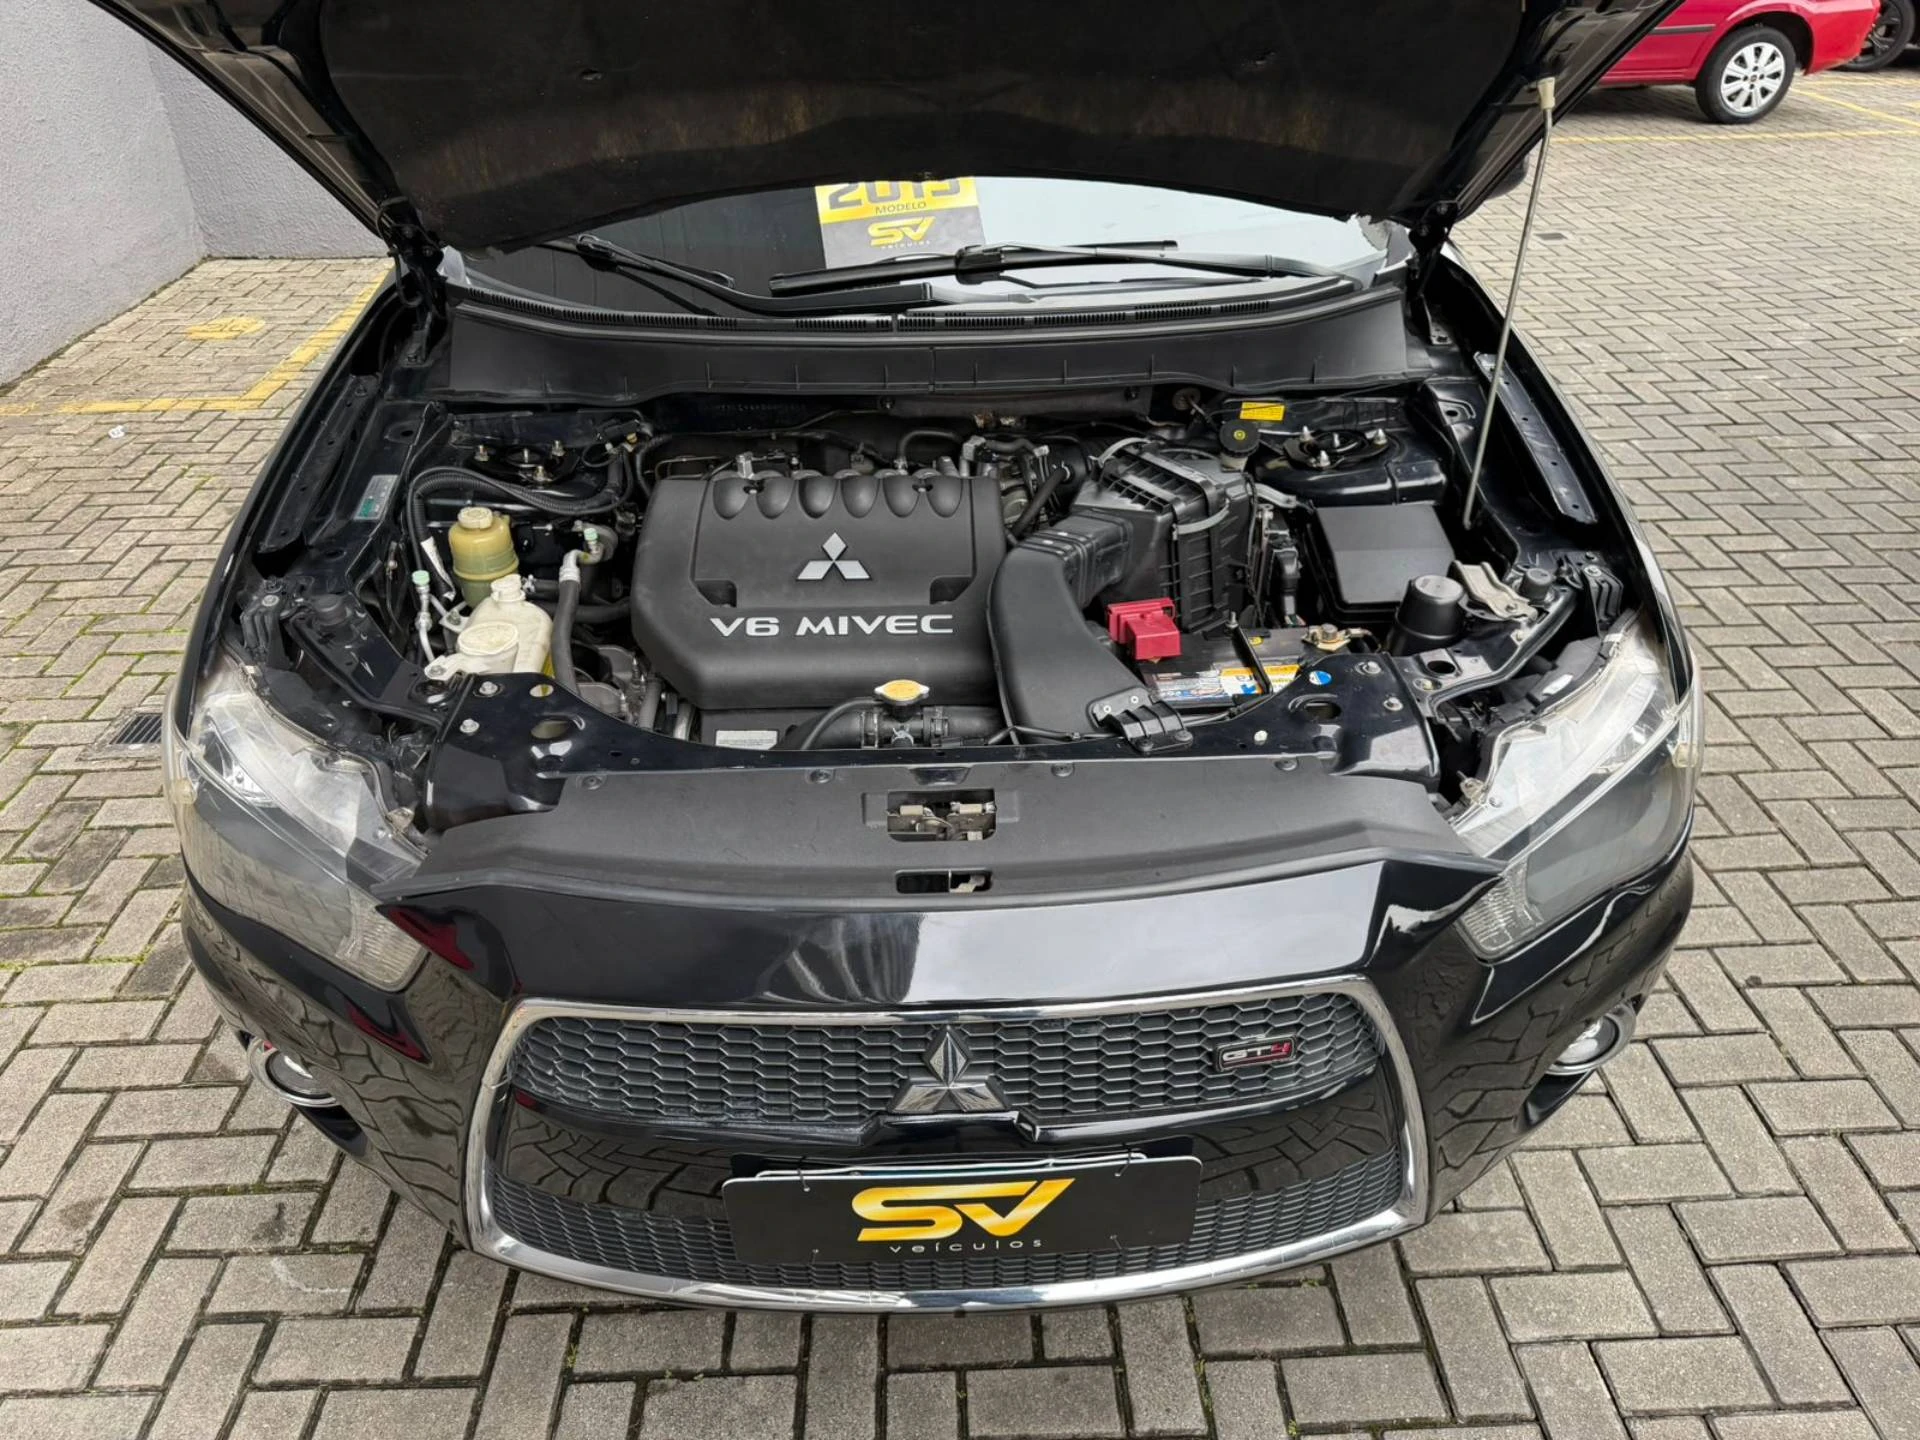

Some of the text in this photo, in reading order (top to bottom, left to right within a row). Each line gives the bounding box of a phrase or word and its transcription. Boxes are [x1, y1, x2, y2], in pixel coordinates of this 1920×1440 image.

[875, 201, 927, 214] MODELO
[868, 216, 936, 247] SV
[710, 614, 954, 637] V6 MIVEC
[851, 1178, 1076, 1242] SV
